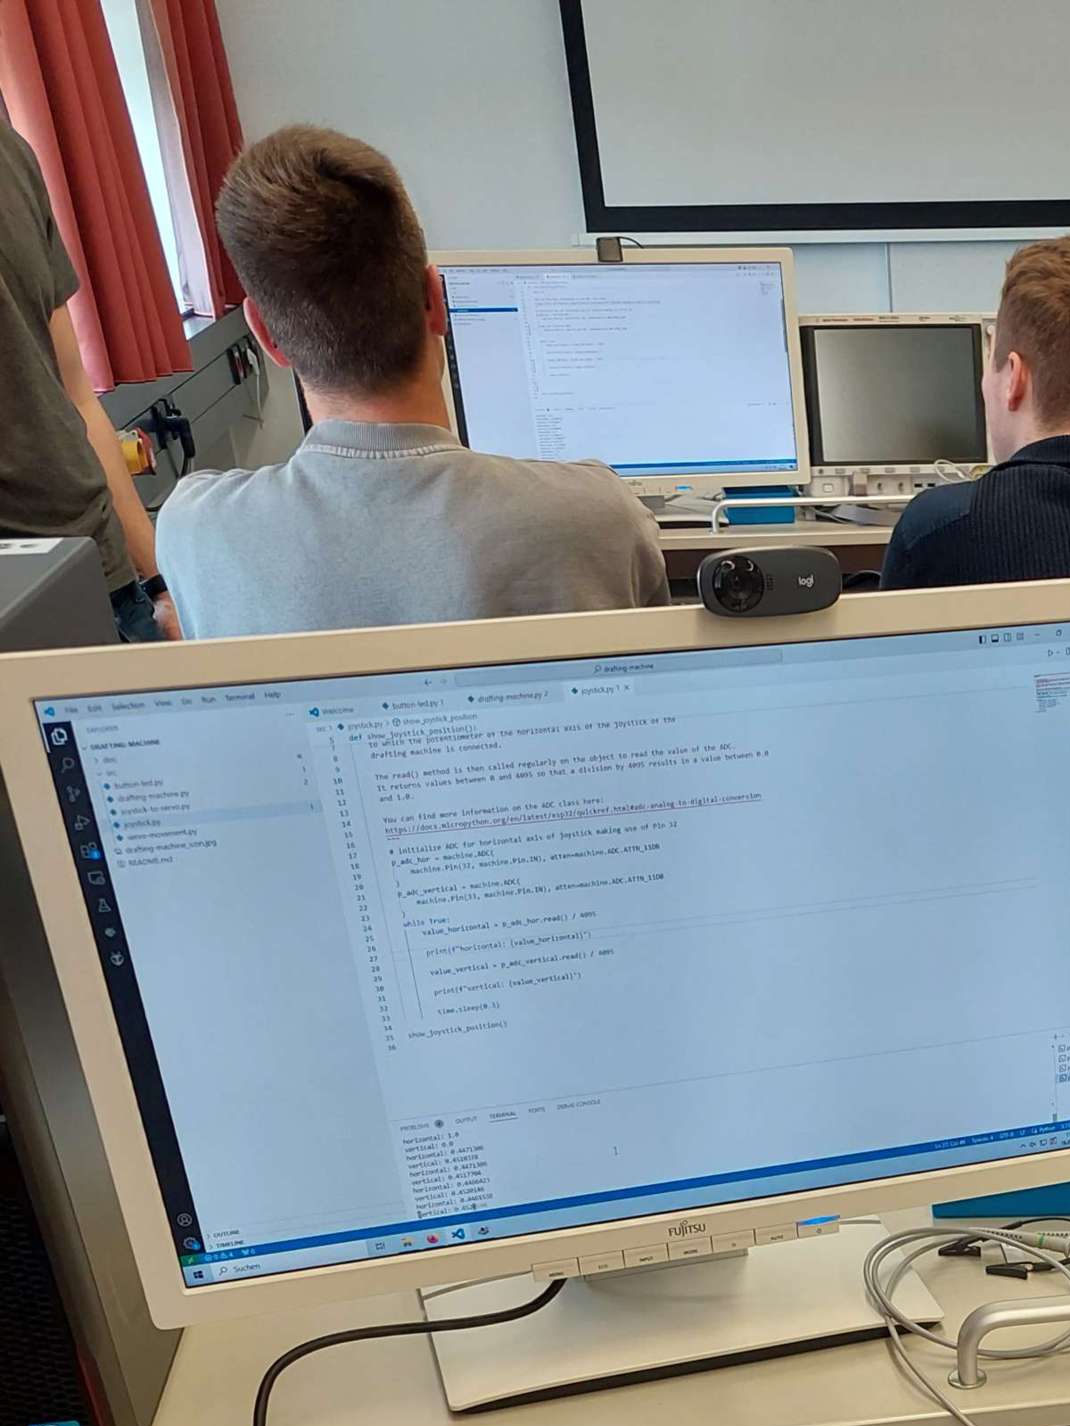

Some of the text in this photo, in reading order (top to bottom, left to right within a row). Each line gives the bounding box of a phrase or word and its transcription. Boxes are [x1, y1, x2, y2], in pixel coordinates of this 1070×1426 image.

[369, 748, 406, 760] drafting
[409, 745, 441, 755] machine
[457, 740, 501, 751] connected.
[392, 769, 420, 780] read()
[422, 767, 450, 776] method
[466, 764, 484, 772] then
[487, 761, 514, 770] called
[517, 757, 556, 769] regularly
[588, 752, 614, 763] object
[630, 749, 647, 757] read
[666, 745, 687, 754] value
[417, 812, 436, 820] find
[460, 805, 508, 816] information
[558, 798, 579, 806] class
[582, 795, 604, 804] here:
[668, 1220, 706, 1237] FUJITSU
